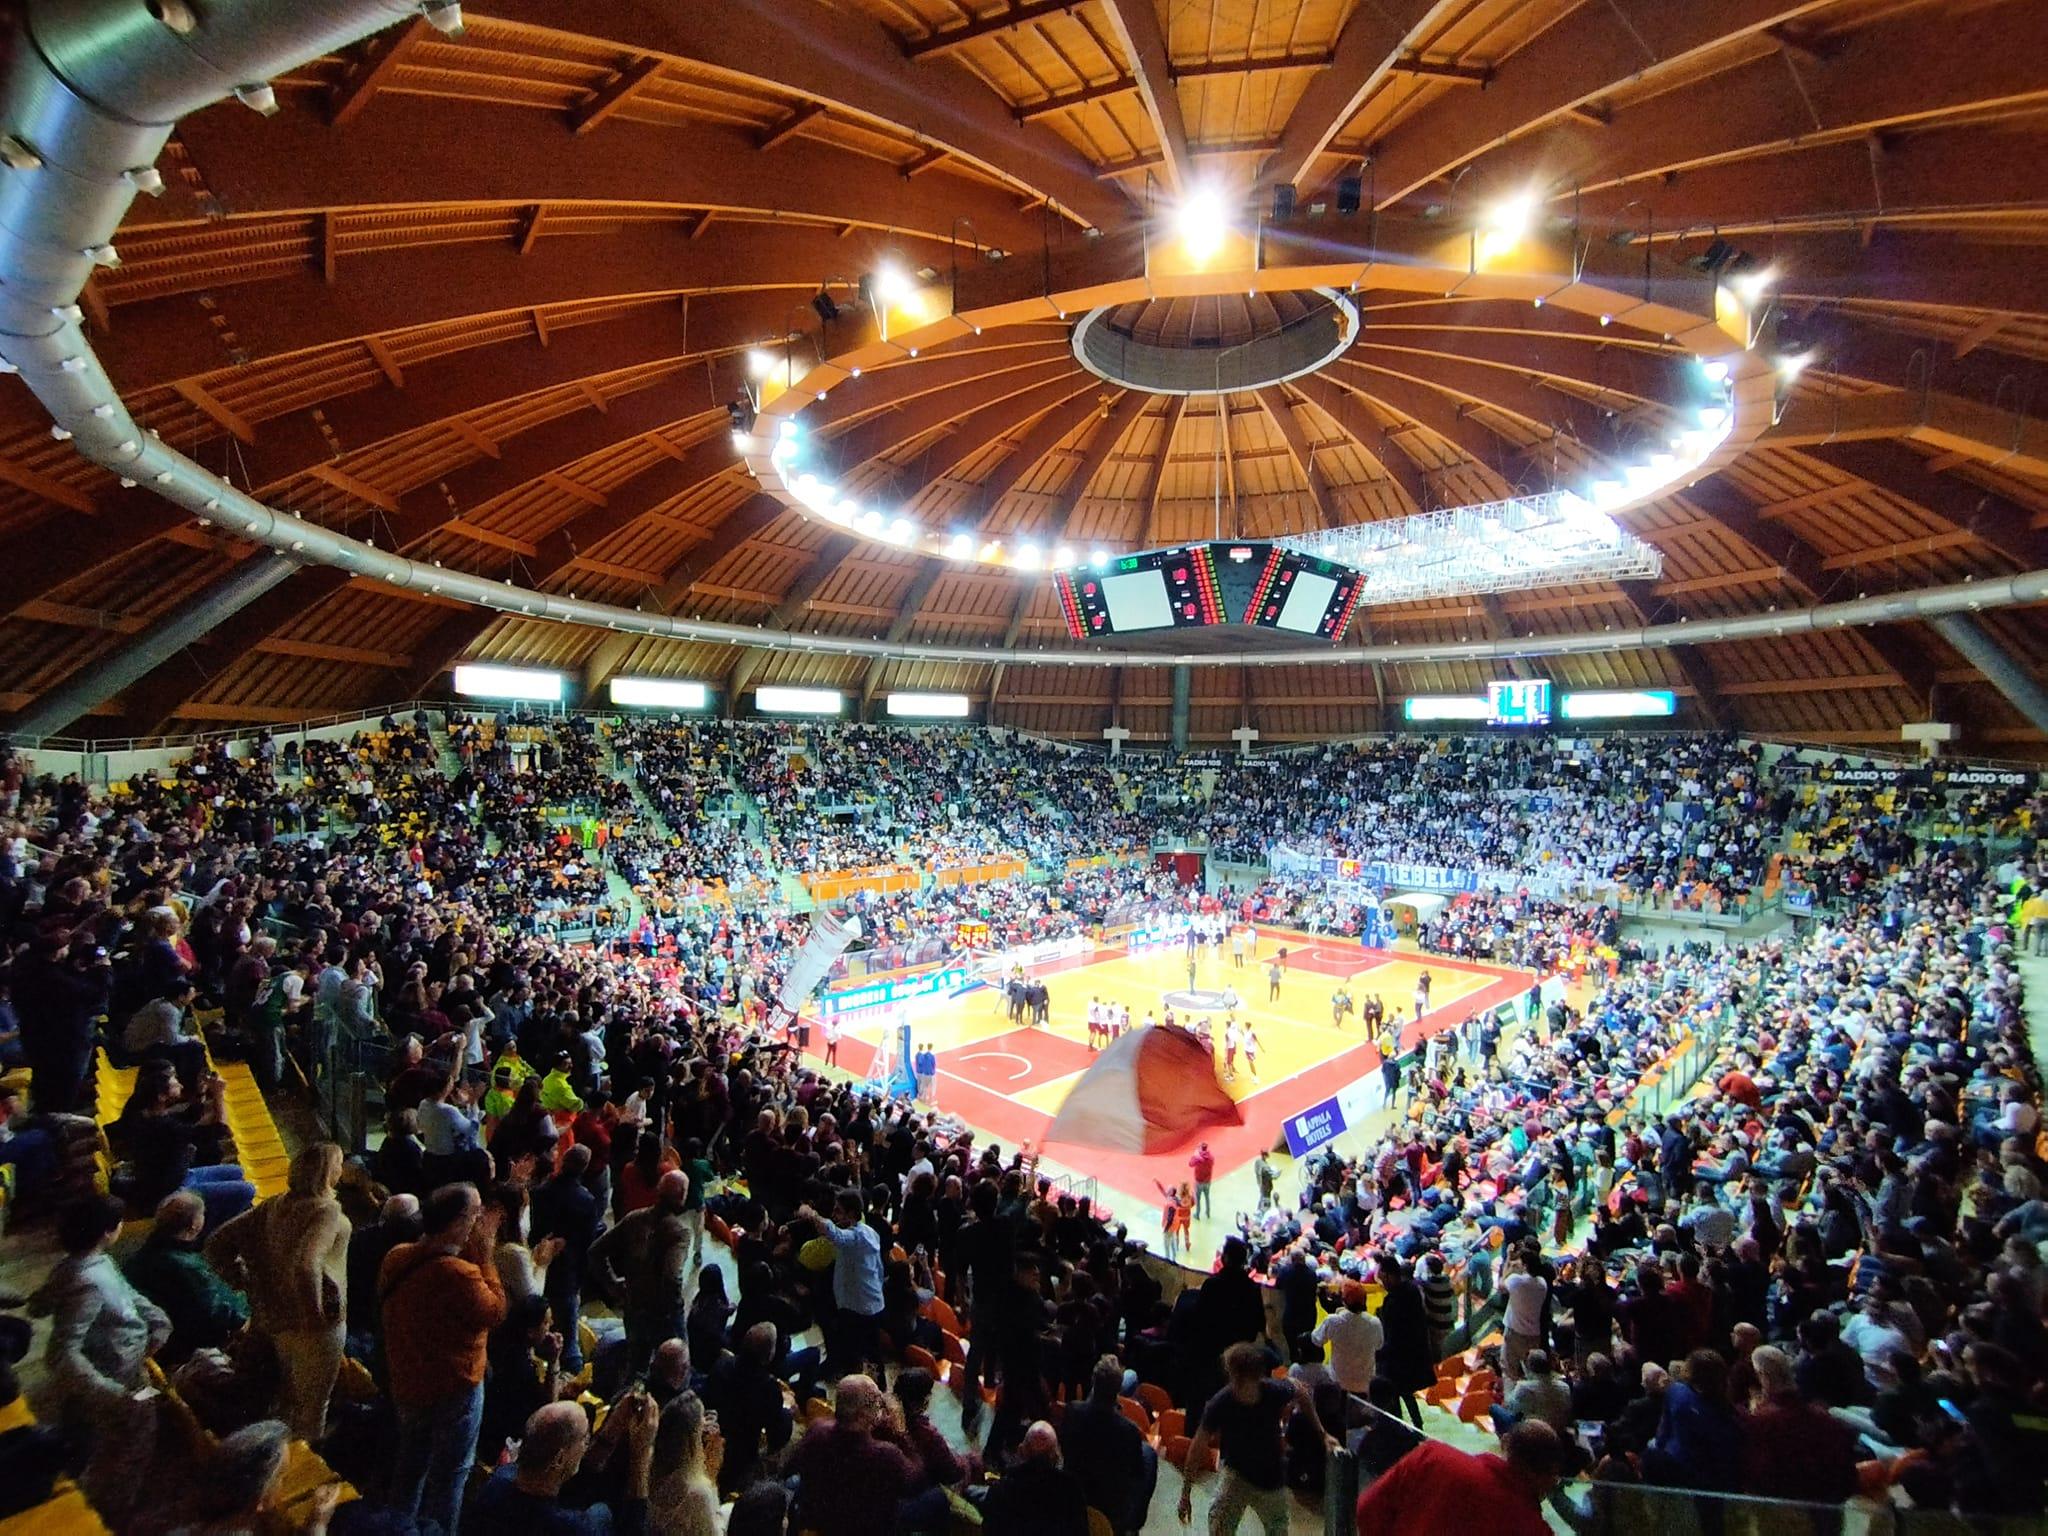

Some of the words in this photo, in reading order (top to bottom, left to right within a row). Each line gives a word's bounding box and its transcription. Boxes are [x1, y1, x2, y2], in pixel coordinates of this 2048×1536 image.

[1834, 770, 1879, 780] RADIO
[1947, 772, 1997, 784] RADIO
[1998, 773, 2026, 785] 105
[1305, 1123, 1332, 1146] HOTELS
